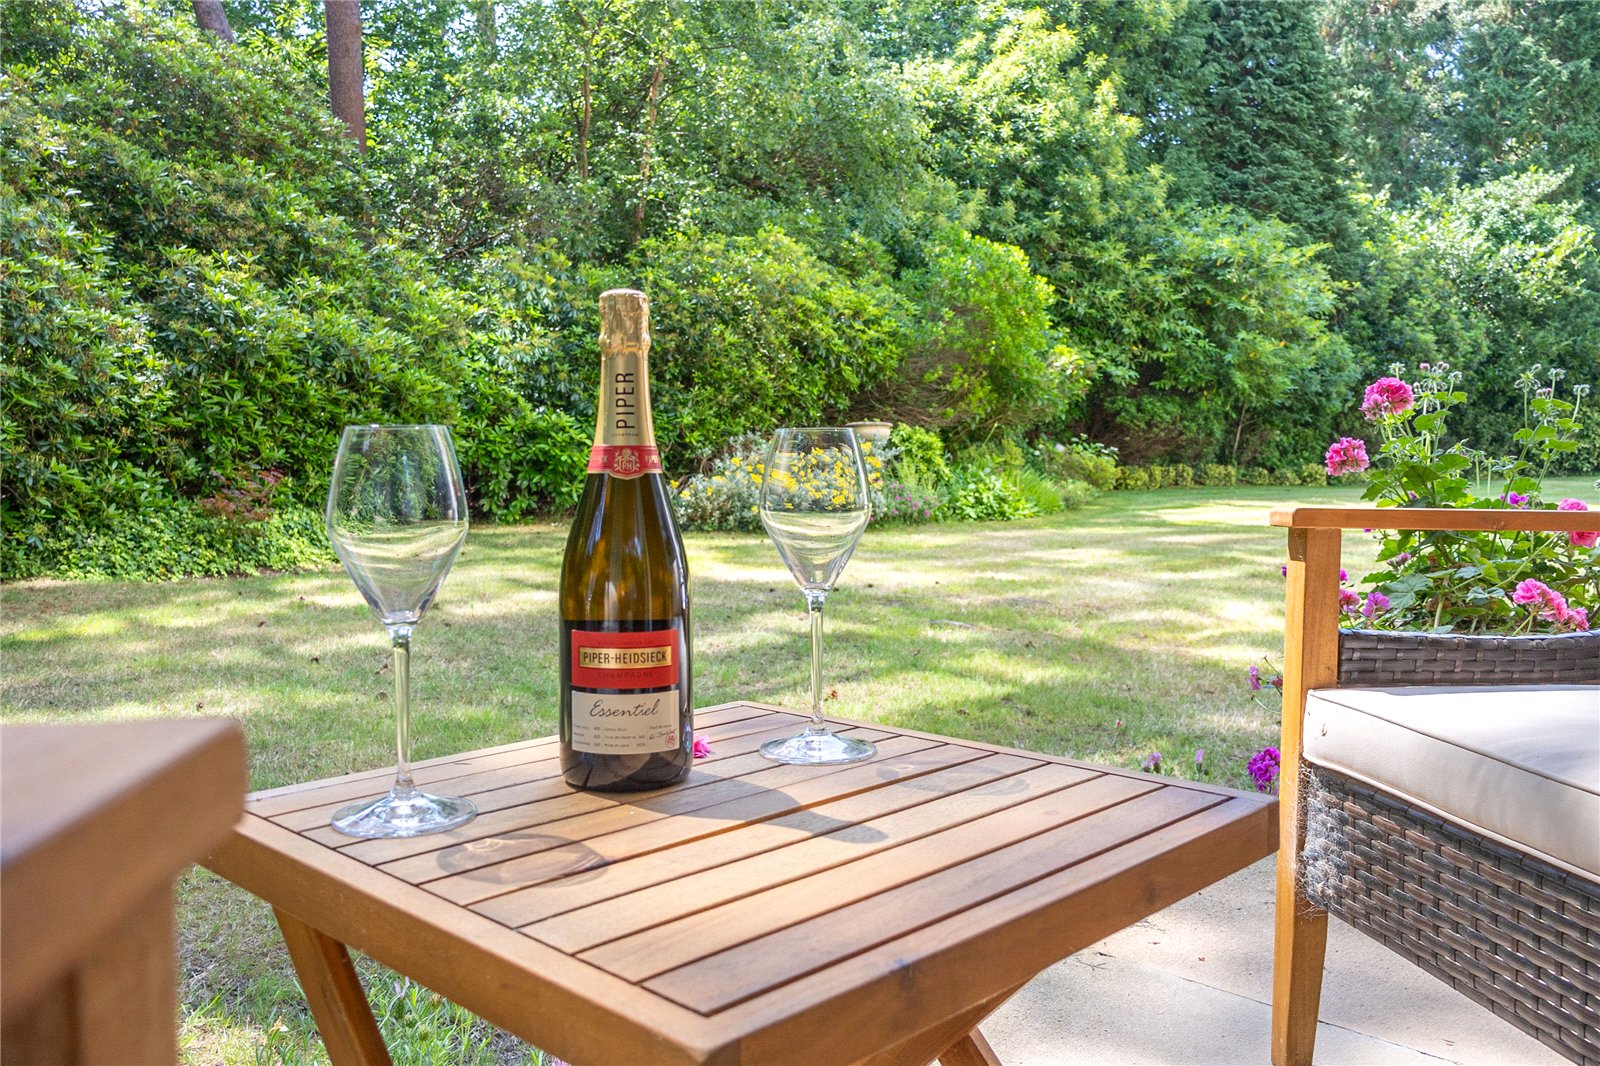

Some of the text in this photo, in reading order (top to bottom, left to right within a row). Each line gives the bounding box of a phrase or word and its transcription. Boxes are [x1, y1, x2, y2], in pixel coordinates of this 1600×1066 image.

[616, 373, 635, 429] PIPER
[583, 650, 667, 664] PIPER-HEIDSIECK
[589, 699, 660, 717] Essentiel
